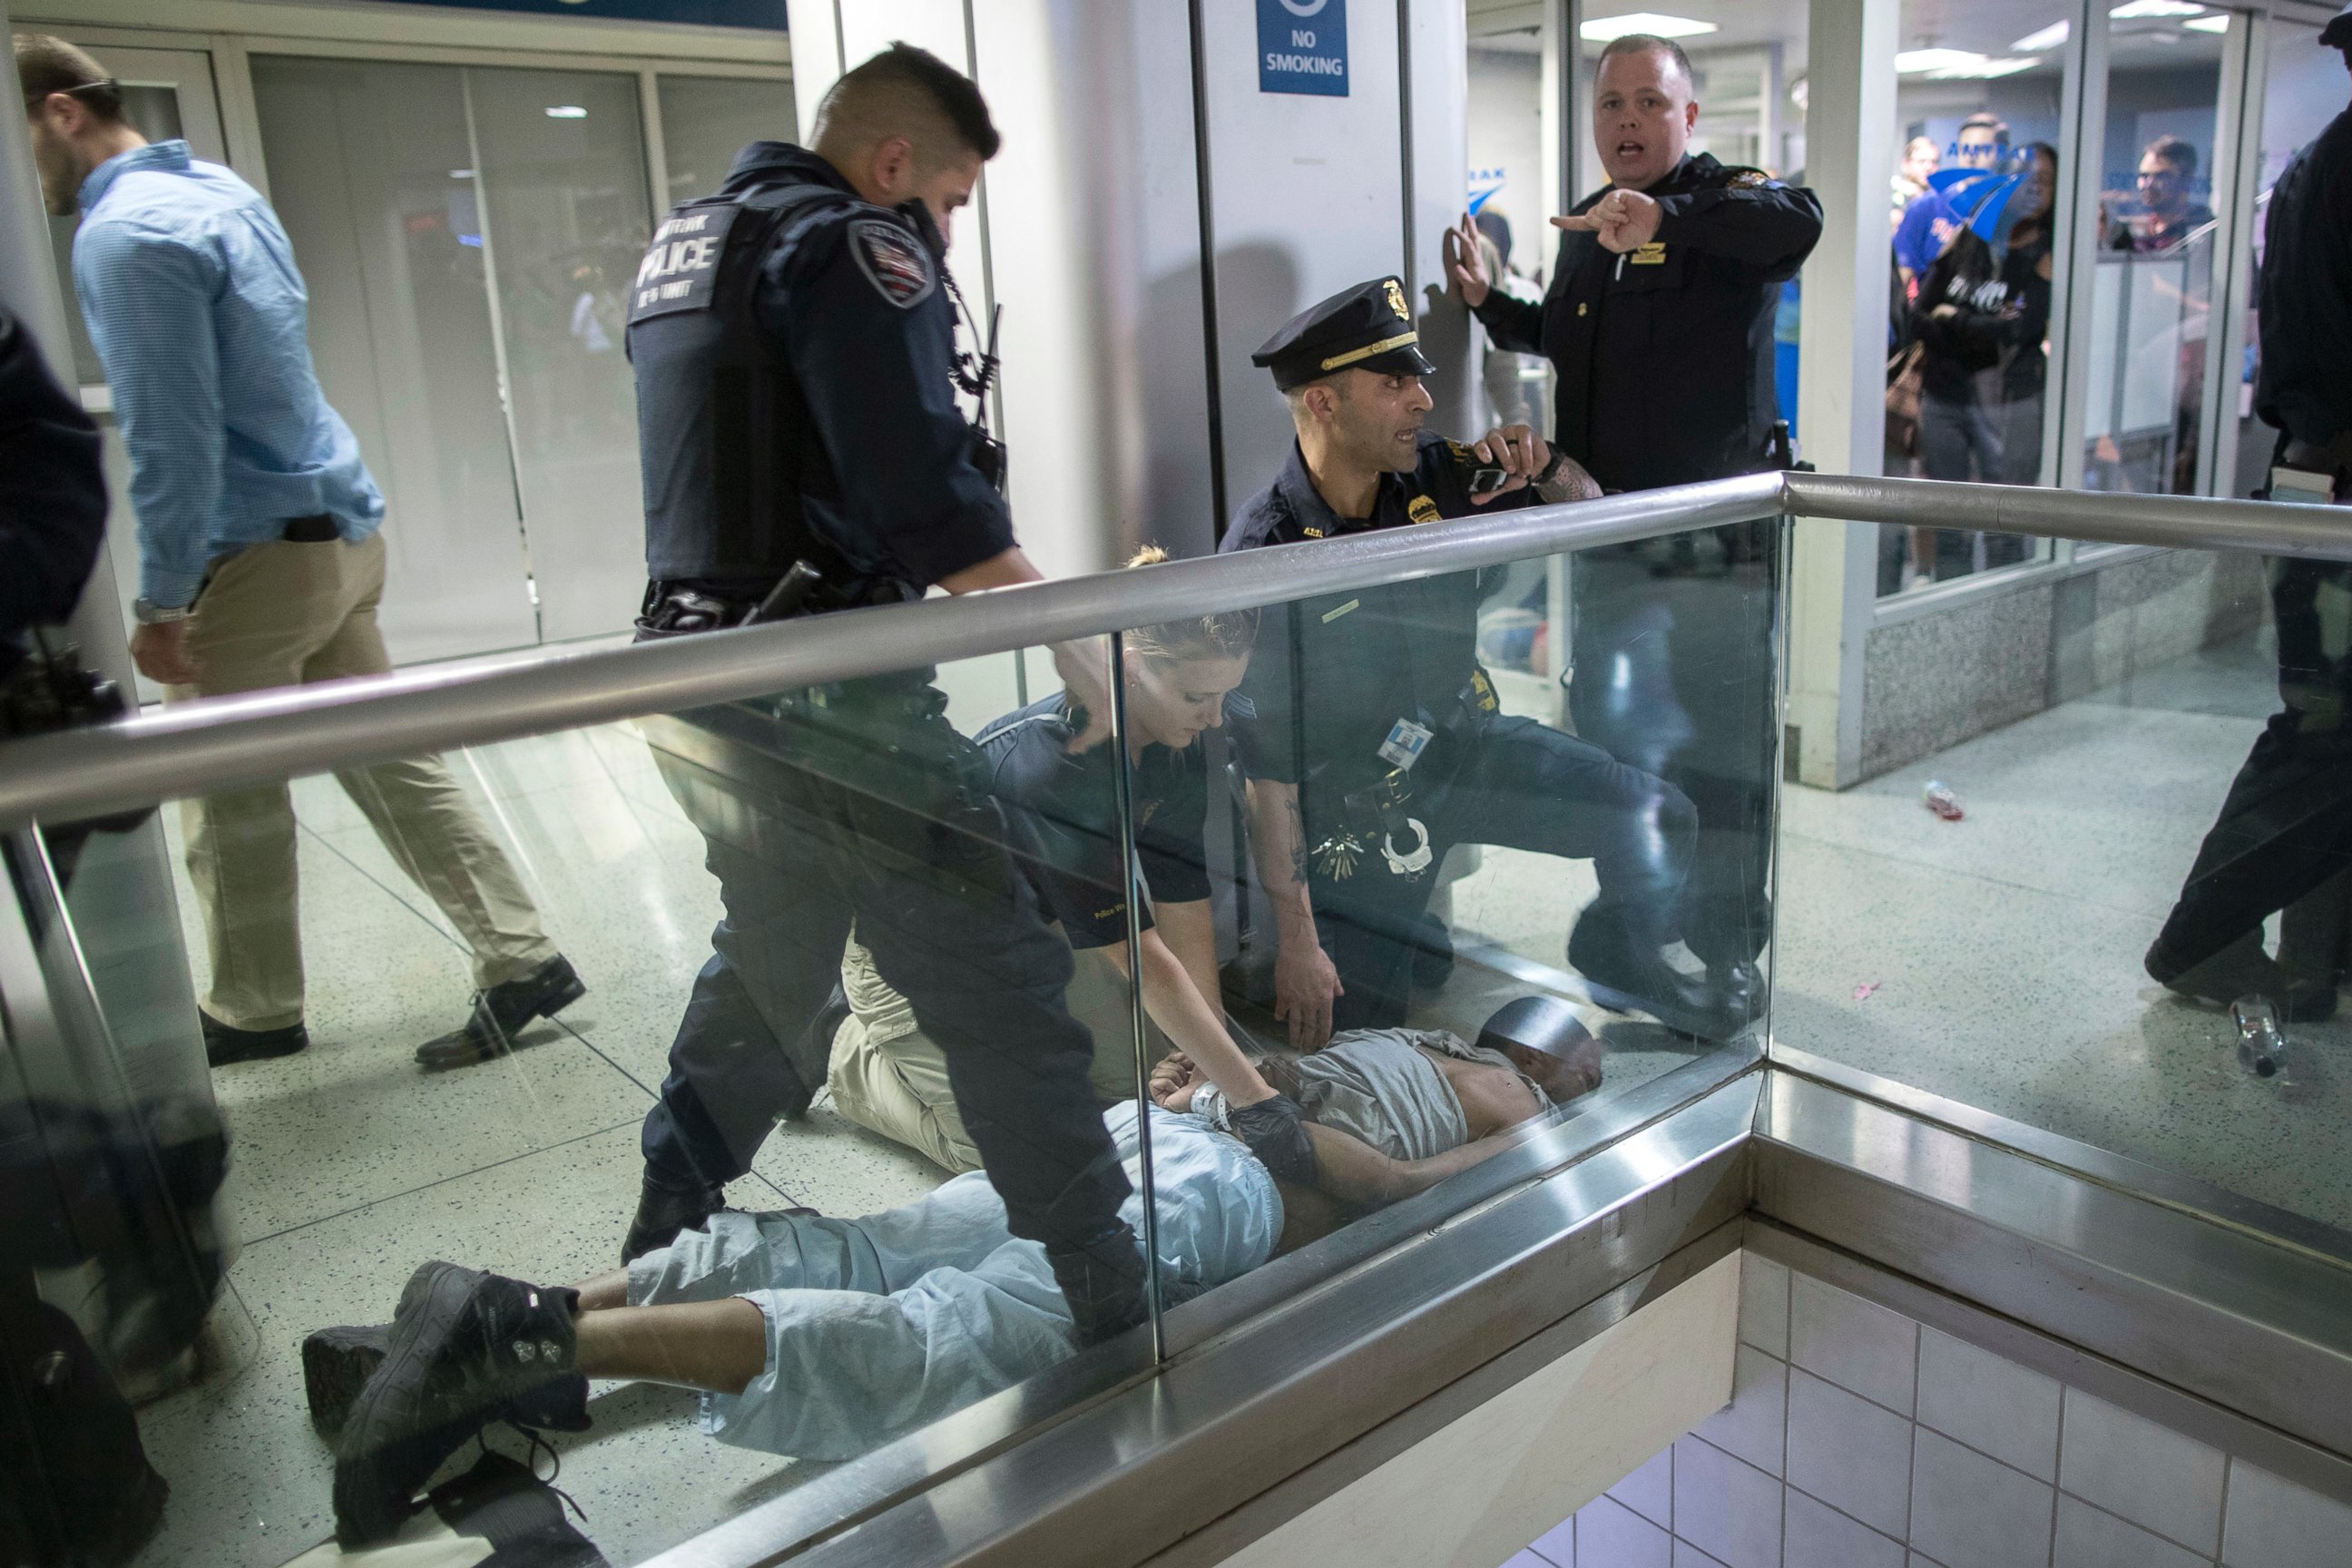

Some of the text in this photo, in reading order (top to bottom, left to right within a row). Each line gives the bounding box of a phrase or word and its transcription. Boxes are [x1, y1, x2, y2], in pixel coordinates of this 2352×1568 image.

[1291, 29, 1317, 48] NO
[1266, 53, 1343, 76] SMOKING
[635, 237, 720, 288] POLICE
[1094, 908, 1115, 920] Police
